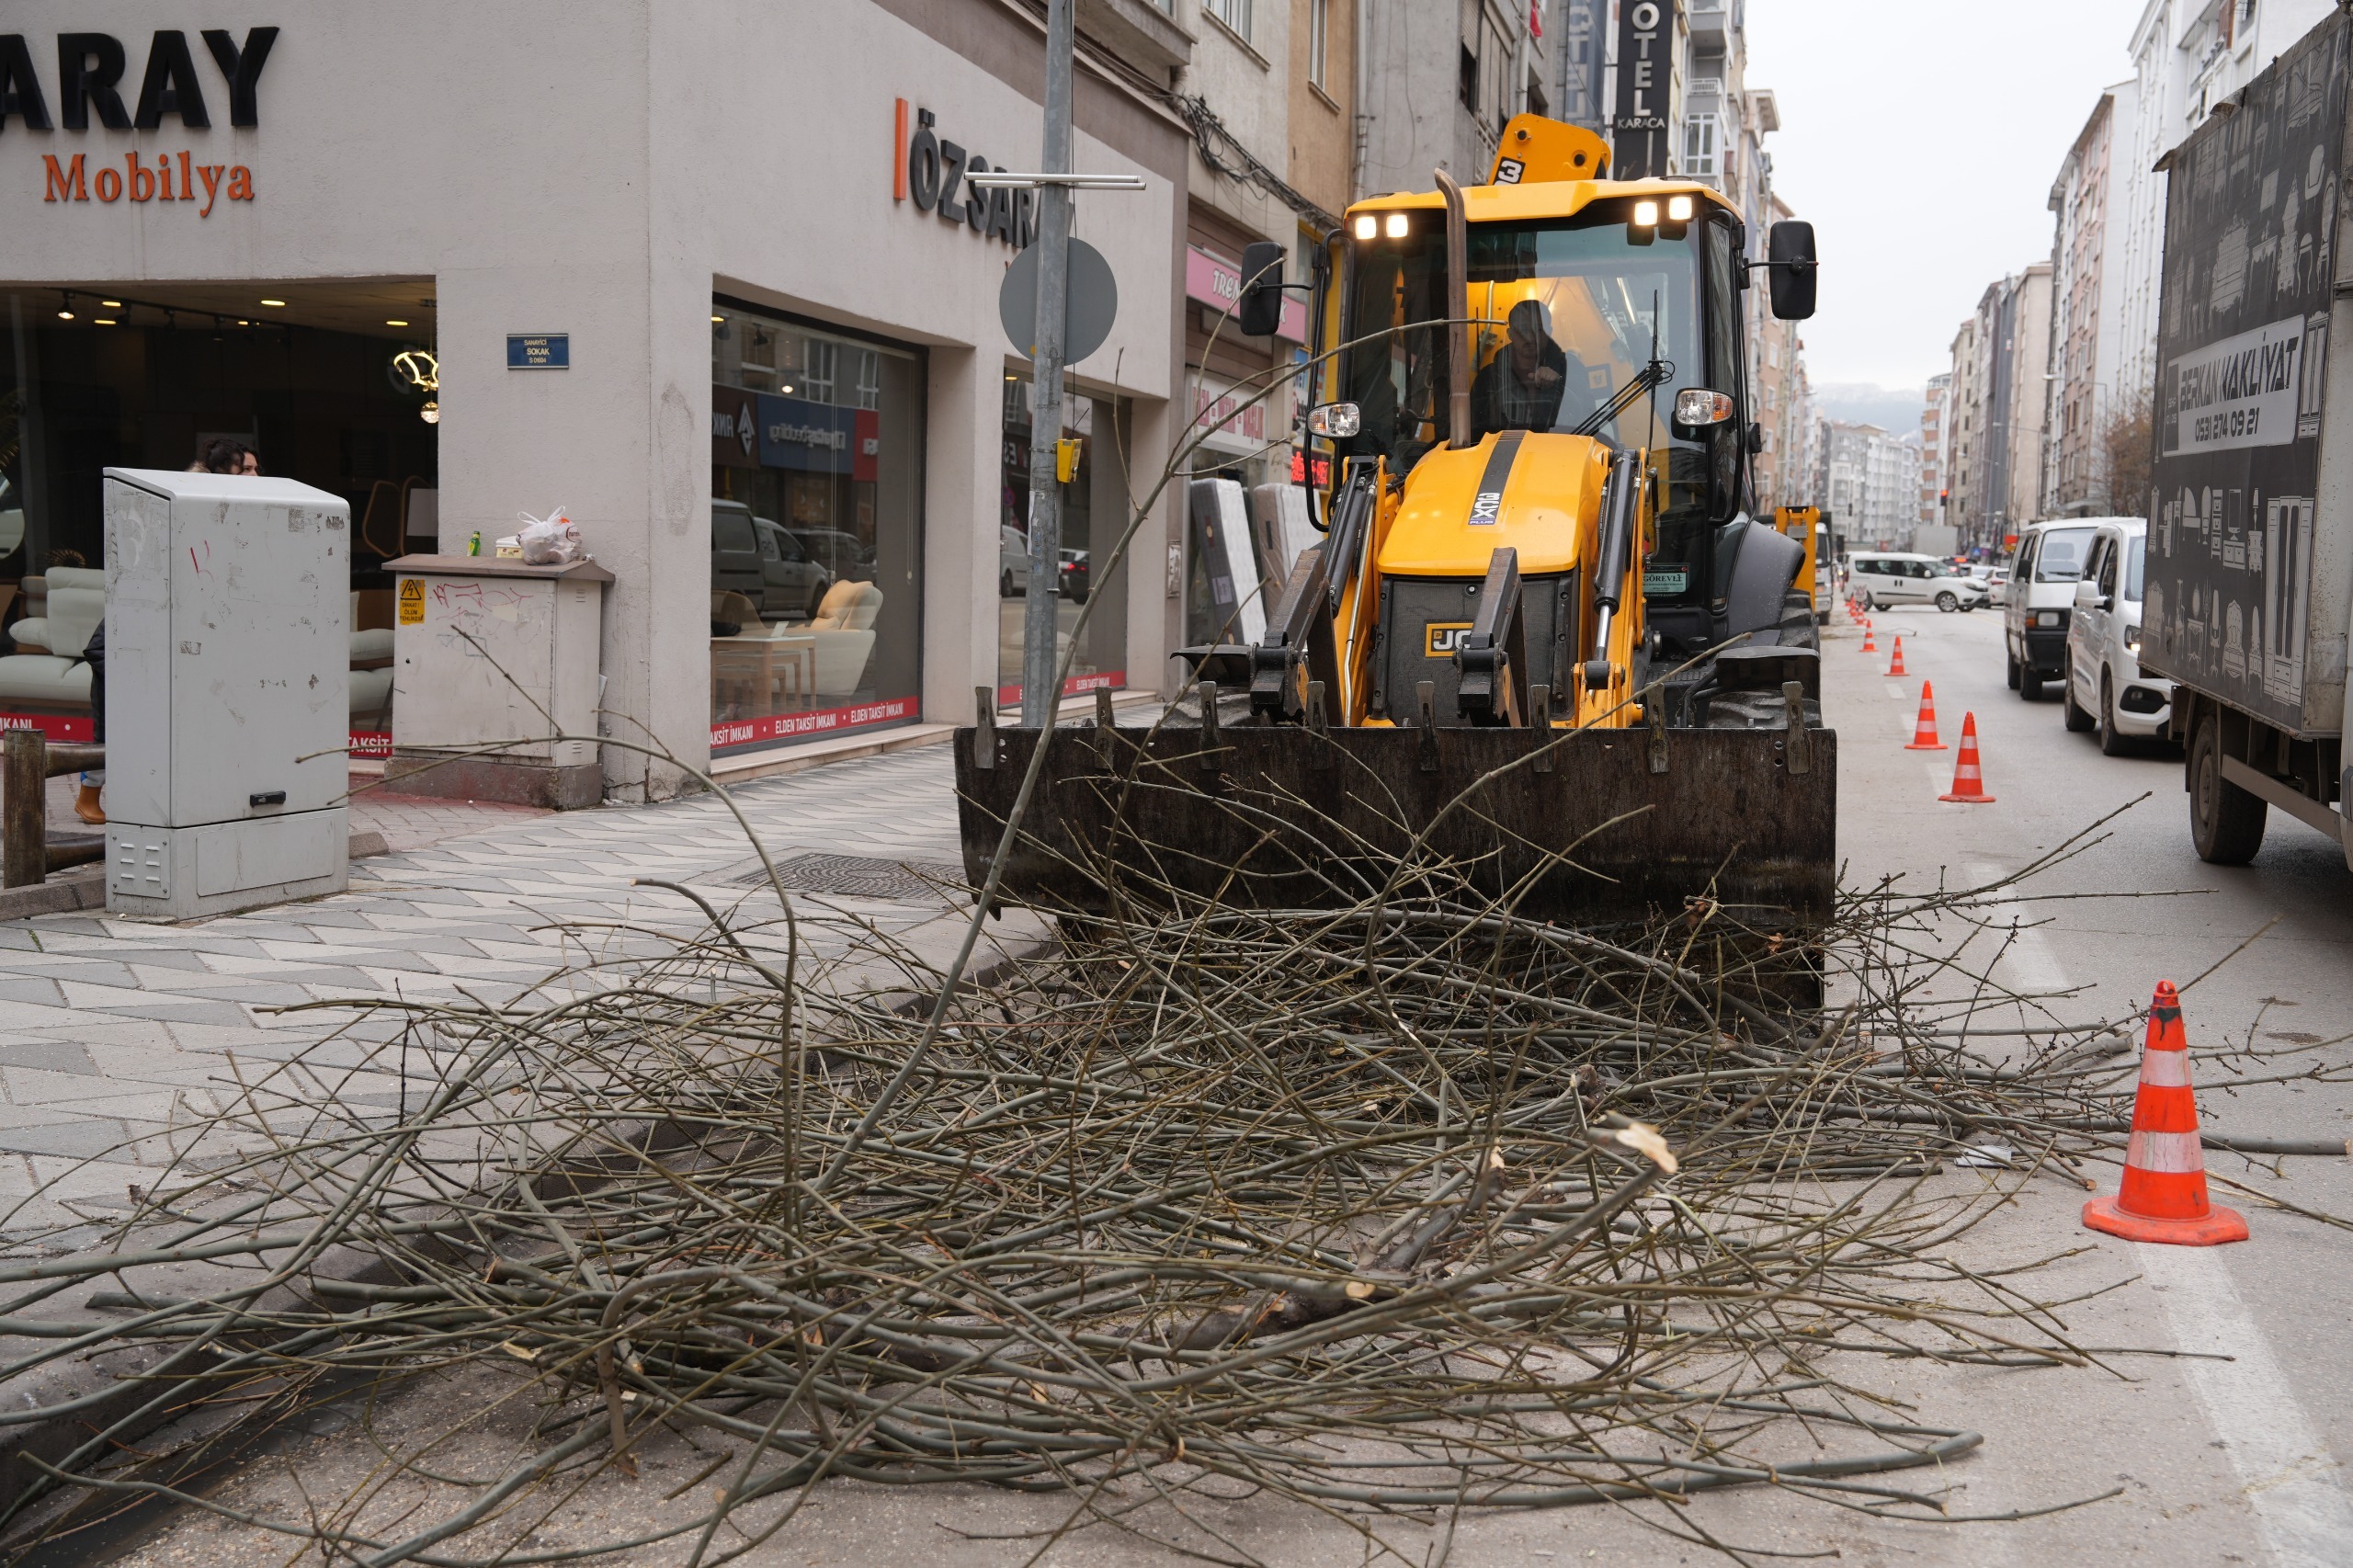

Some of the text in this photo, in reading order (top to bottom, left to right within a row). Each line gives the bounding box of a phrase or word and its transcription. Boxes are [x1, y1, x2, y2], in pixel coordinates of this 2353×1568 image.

[1632, 0, 1660, 117] OTEL
[0, 27, 279, 131] ARAY
[1618, 117, 1665, 129] KARACA
[42, 150, 255, 218] Mobilya
[910, 108, 1074, 250] ÖZSAR
[1495, 160, 1522, 186] 3
[1212, 268, 1241, 301] TREN
[524, 338, 547, 347] SANAYİCİ
[527, 347, 550, 356] SOKAK
[2179, 330, 2300, 413] BERKAN NAKLİYAT
[2195, 415, 2211, 442] 0531
[2213, 413, 2228, 439] 274
[2230, 409, 2245, 437] 09
[2246, 407, 2259, 436] 21
[1471, 493, 1500, 518] 3CX
[1433, 630, 1472, 649] JC
[0, 717, 32, 732] KANI
[775, 713, 836, 734] ELDEN TAKSİT İMKANI
[850, 702, 904, 723] ELDEN TAKSİT İMKANI
[710, 724, 753, 745] AKSİT İMKANI
